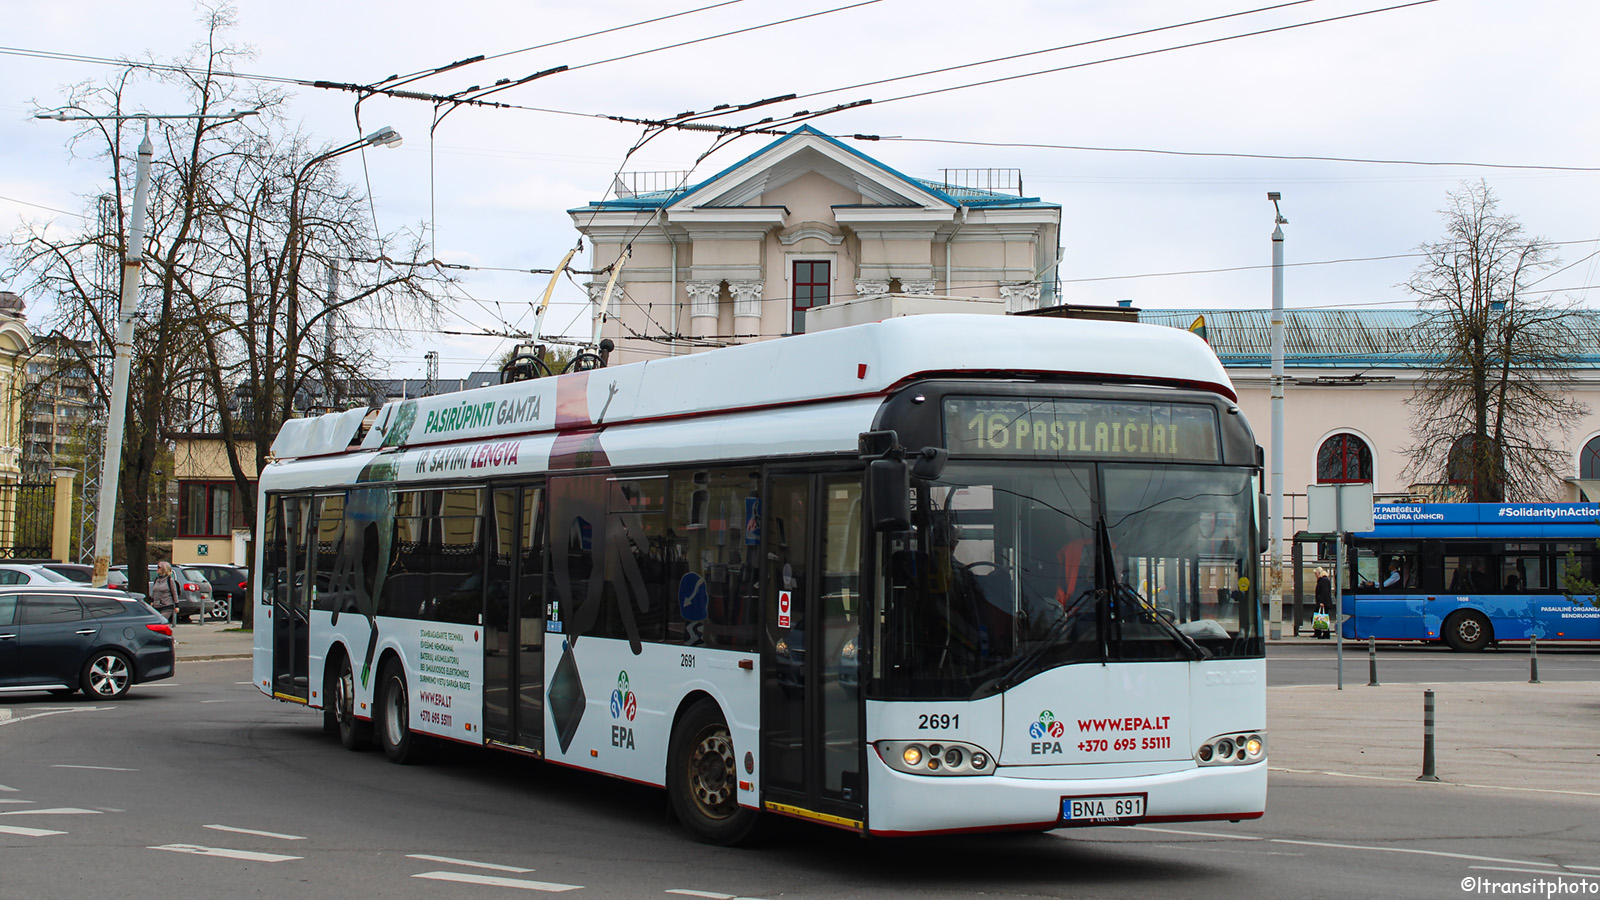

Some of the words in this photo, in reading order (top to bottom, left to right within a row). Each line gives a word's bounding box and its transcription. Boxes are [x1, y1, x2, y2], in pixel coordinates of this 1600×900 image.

[424, 401, 496, 434] PASIRŪPINTI
[497, 394, 541, 425] GAMTA
[968, 413, 1009, 449] 16
[1016, 418, 1178, 454] PASILAIČIAI
[416, 451, 430, 474] IR
[429, 446, 472, 473] SAVIMI
[471, 440, 521, 469] LENGVA
[681, 654, 695, 668] 2691
[420, 691, 452, 708] WWW.EPA.LT
[432, 712, 440, 724] 695
[918, 714, 959, 729] 2691
[1077, 716, 1170, 732] WWW.EPA.LT
[611, 725, 635, 750] EPA
[1077, 739, 1108, 752] +370
[1113, 738, 1136, 751] 695
[1141, 736, 1170, 750] 55111
[1031, 742, 1062, 755] EPA
[1073, 800, 1105, 817] BNA
[1116, 799, 1140, 815] 691
